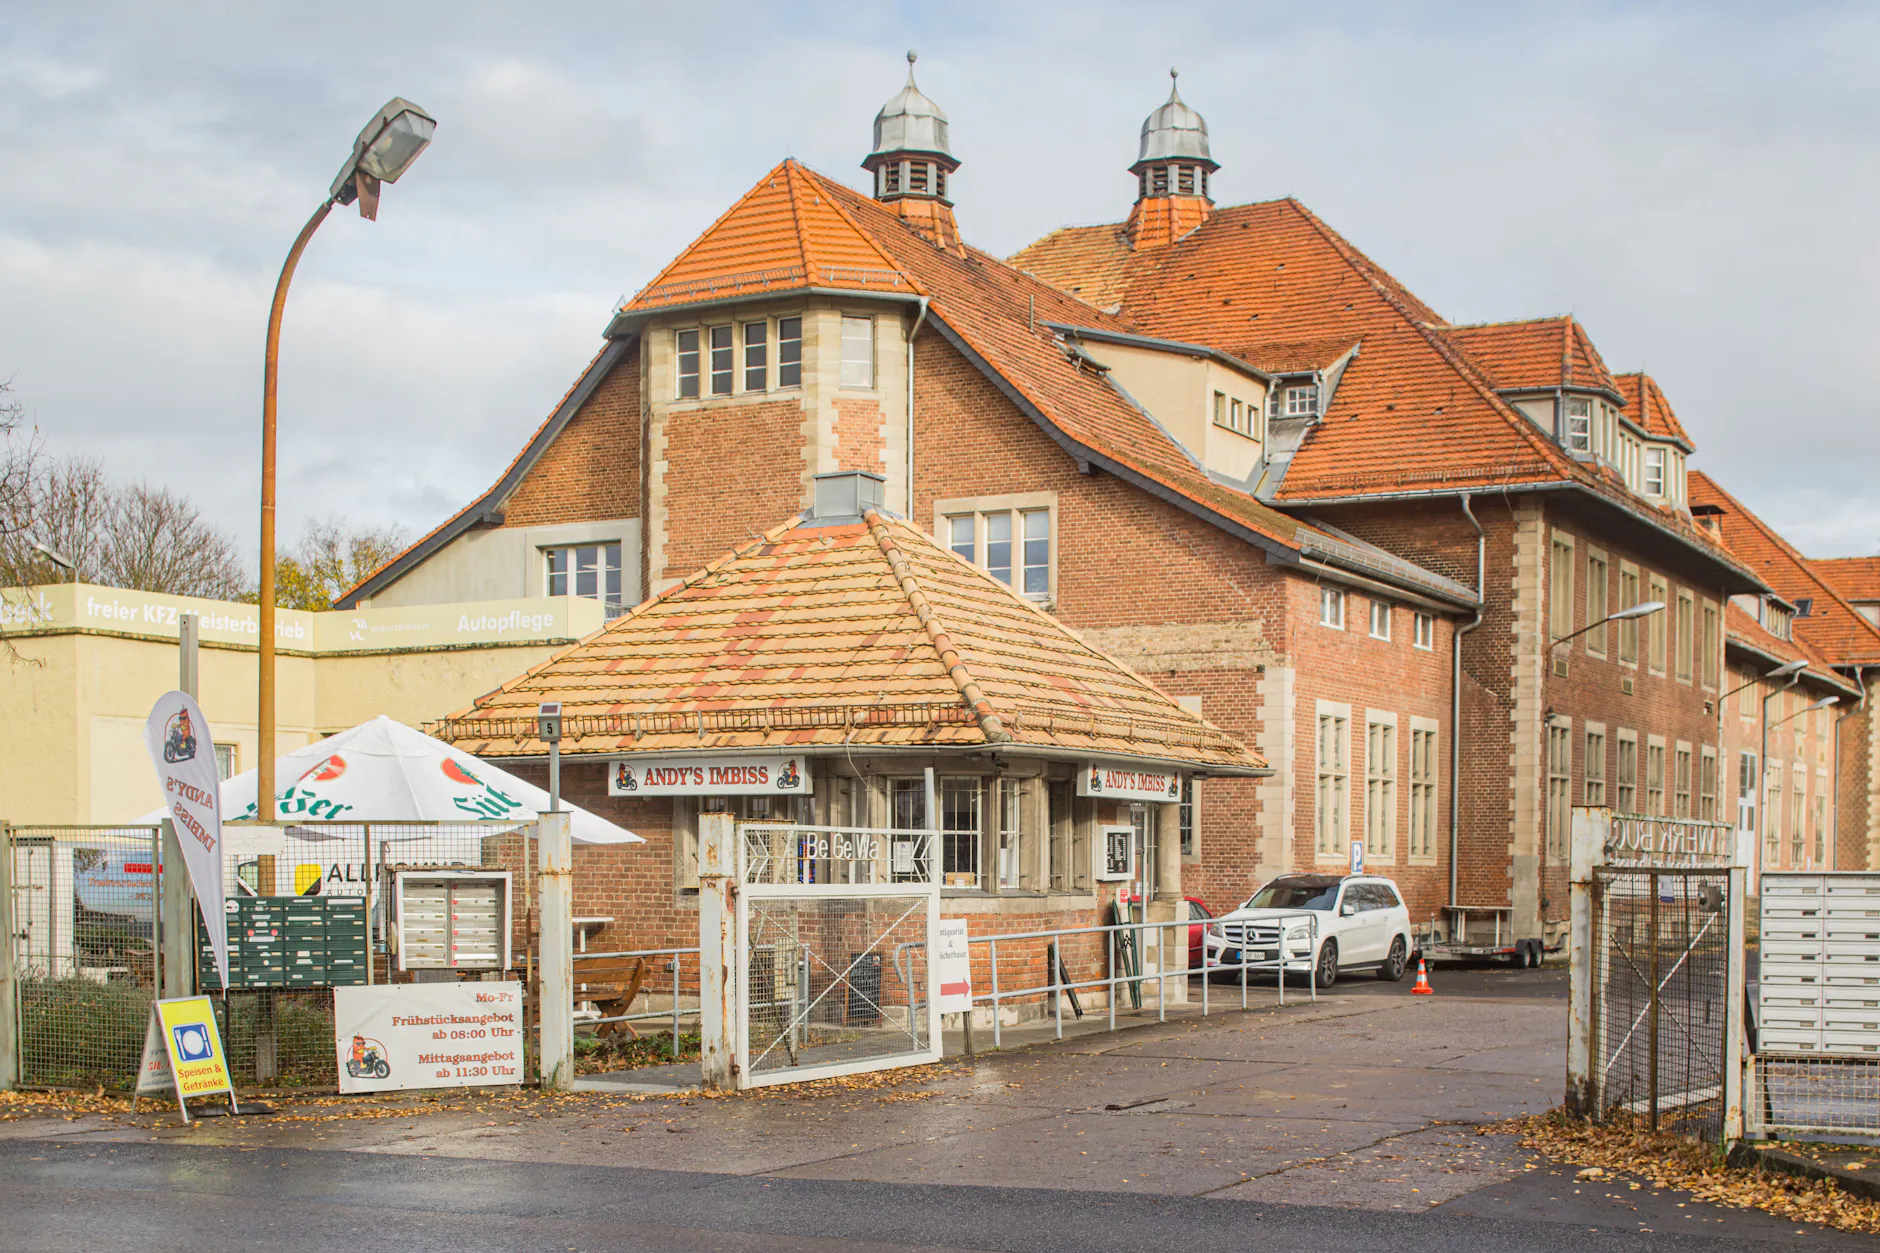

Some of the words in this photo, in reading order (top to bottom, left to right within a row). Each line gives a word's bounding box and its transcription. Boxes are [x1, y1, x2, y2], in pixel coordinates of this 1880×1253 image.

[87, 596, 138, 620] freier
[457, 610, 554, 635] Autopflege
[547, 723, 553, 735] 5
[643, 766, 704, 786] ANDY'S
[708, 765, 769, 785] IMBISS
[1105, 770, 1136, 790] ANDY'S
[1137, 773, 1166, 792] IMBISS
[940, 927, 964, 938] ntiquariat
[475, 992, 514, 1003] Mo-Fr
[392, 1012, 514, 1027] Frühstücksangebot
[432, 1030, 447, 1040] ab
[450, 1029, 486, 1040] 08:00
[491, 1027, 515, 1037] Uhr
[418, 1050, 515, 1065] Mittagsangebot
[178, 1065, 213, 1080] Speisen
[214, 1063, 222, 1073] &
[435, 1068, 451, 1078] ab
[456, 1066, 488, 1078] 11:30
[492, 1065, 516, 1075] Uhr
[183, 1078, 224, 1092] Getränke
